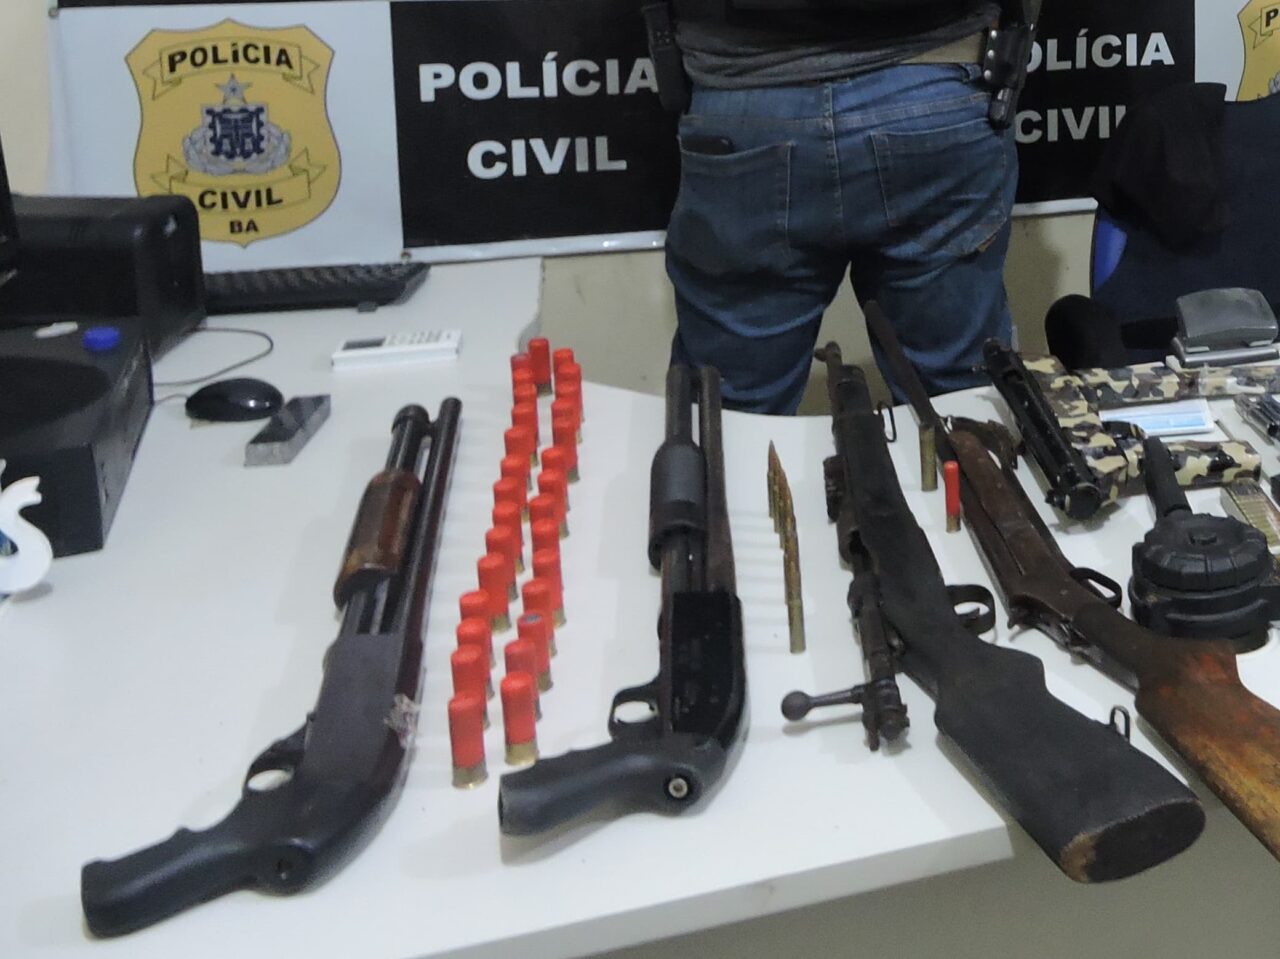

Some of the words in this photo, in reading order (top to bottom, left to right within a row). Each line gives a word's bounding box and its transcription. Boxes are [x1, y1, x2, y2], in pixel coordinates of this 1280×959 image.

[419, 52, 657, 102] POLÍCIA
[467, 137, 626, 179] CIVIL
[199, 188, 283, 209] CIVIL
[230, 220, 258, 234] BA
